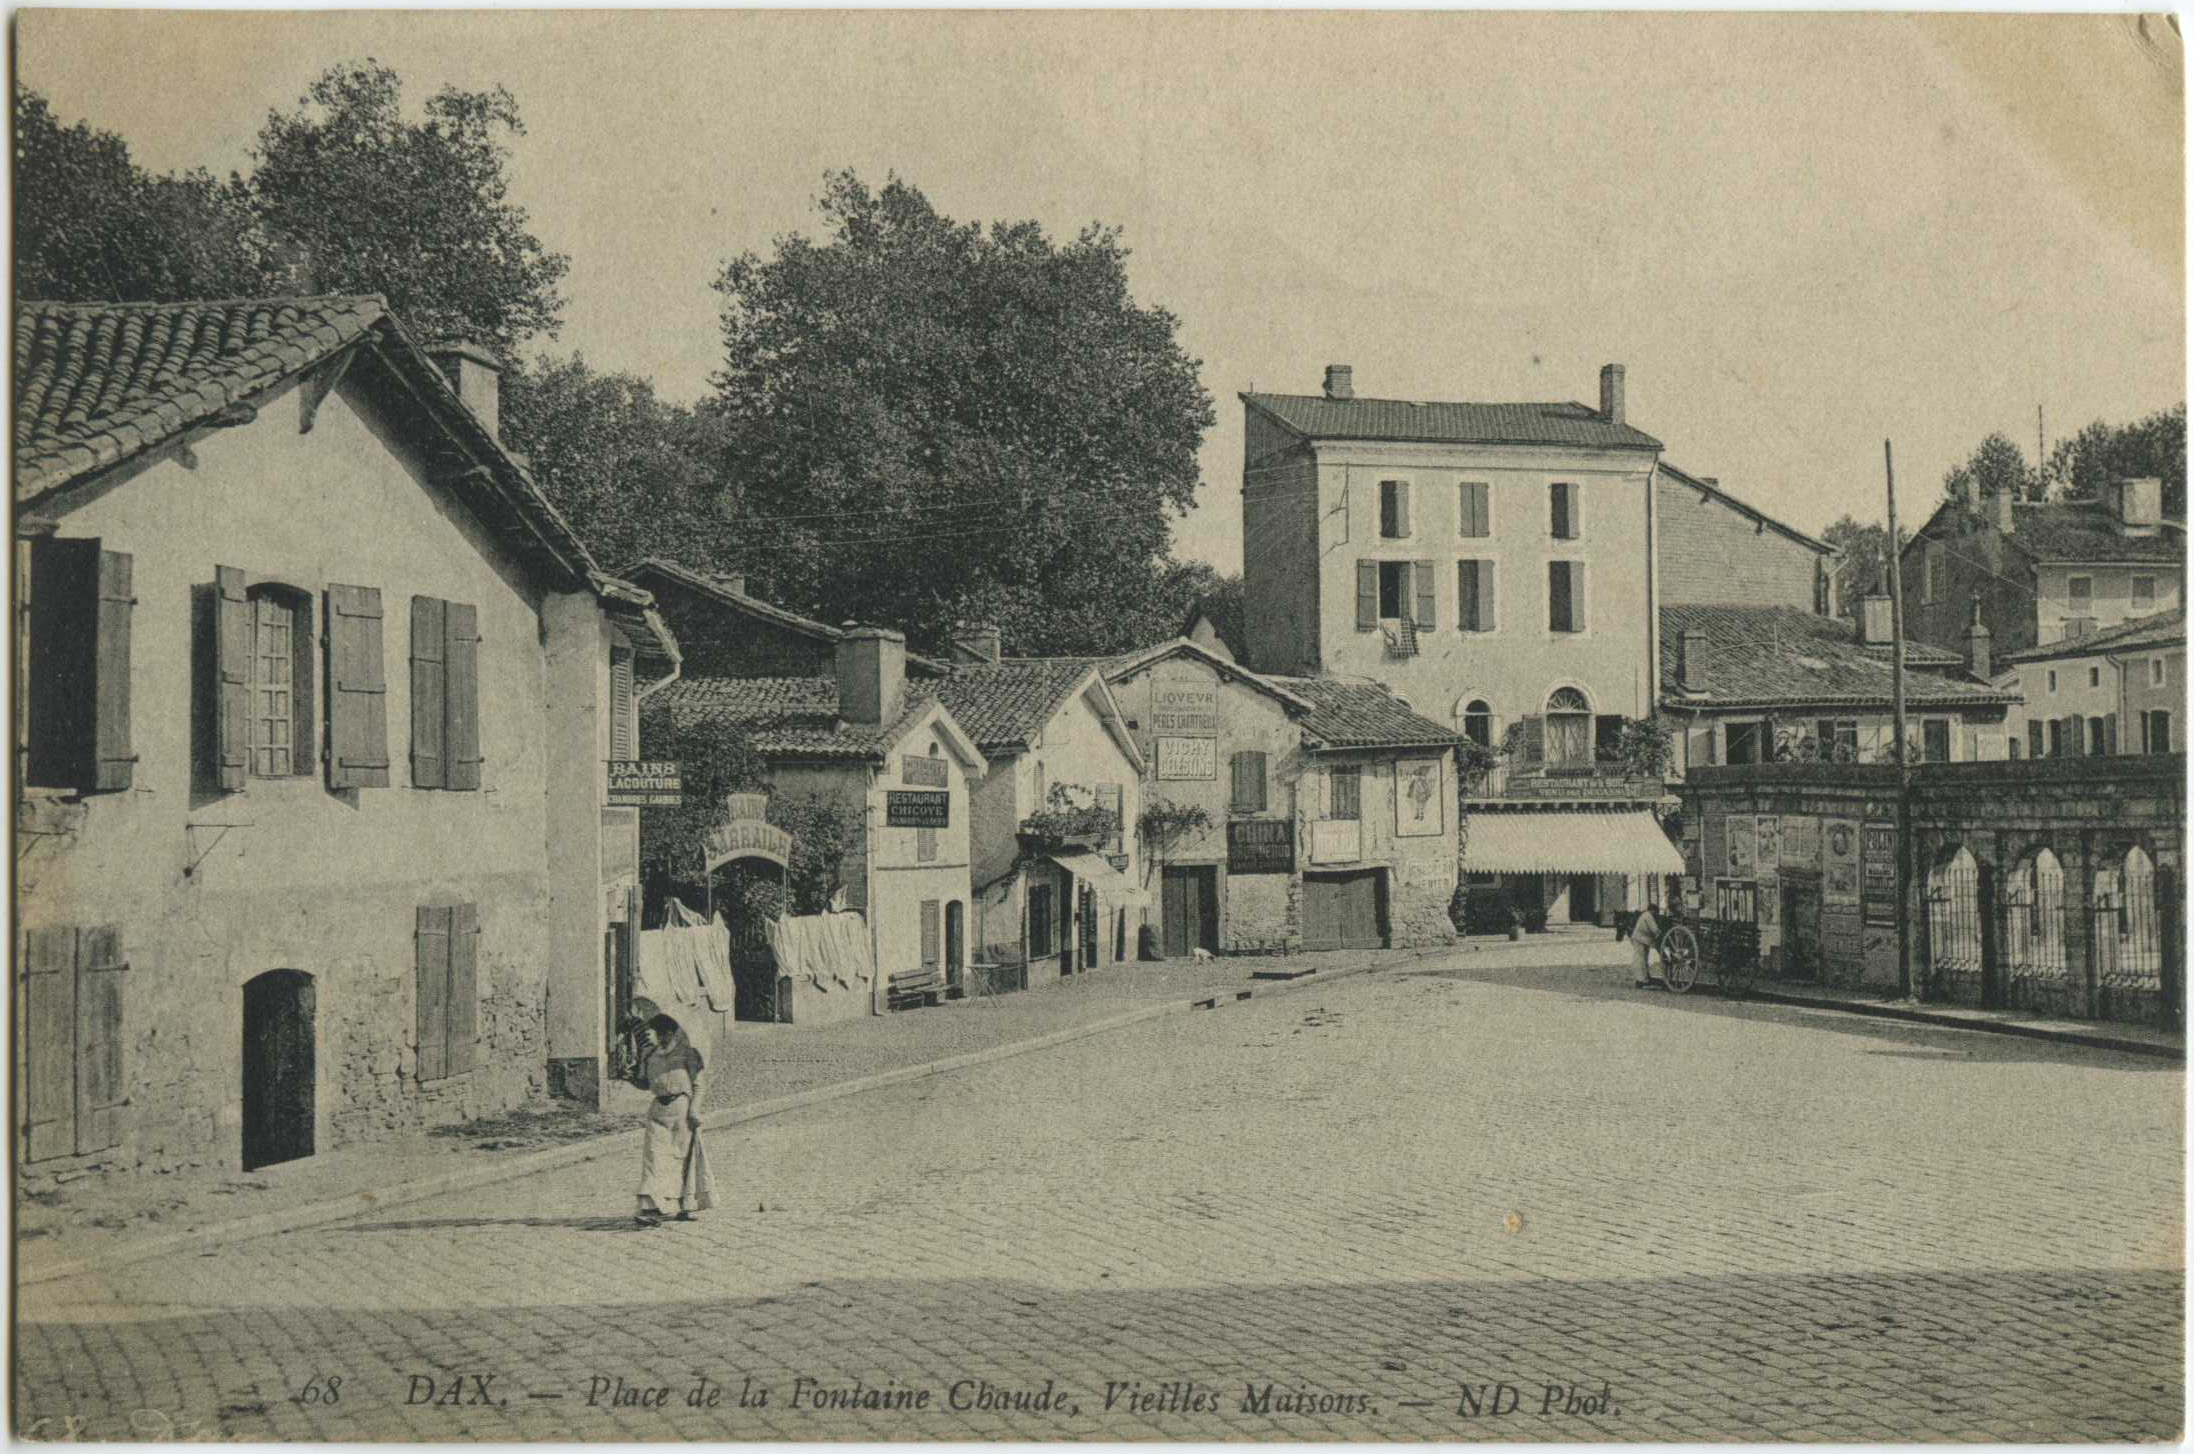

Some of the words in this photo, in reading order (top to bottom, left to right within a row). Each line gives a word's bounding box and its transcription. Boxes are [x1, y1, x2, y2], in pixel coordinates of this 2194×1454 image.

[1165, 741, 1210, 756] VICHY
[609, 762, 676, 777] BAINS
[609, 777, 681, 790] LACOUTURE
[889, 793, 947, 806] RESTAURANT
[1718, 887, 1754, 922] PICON
